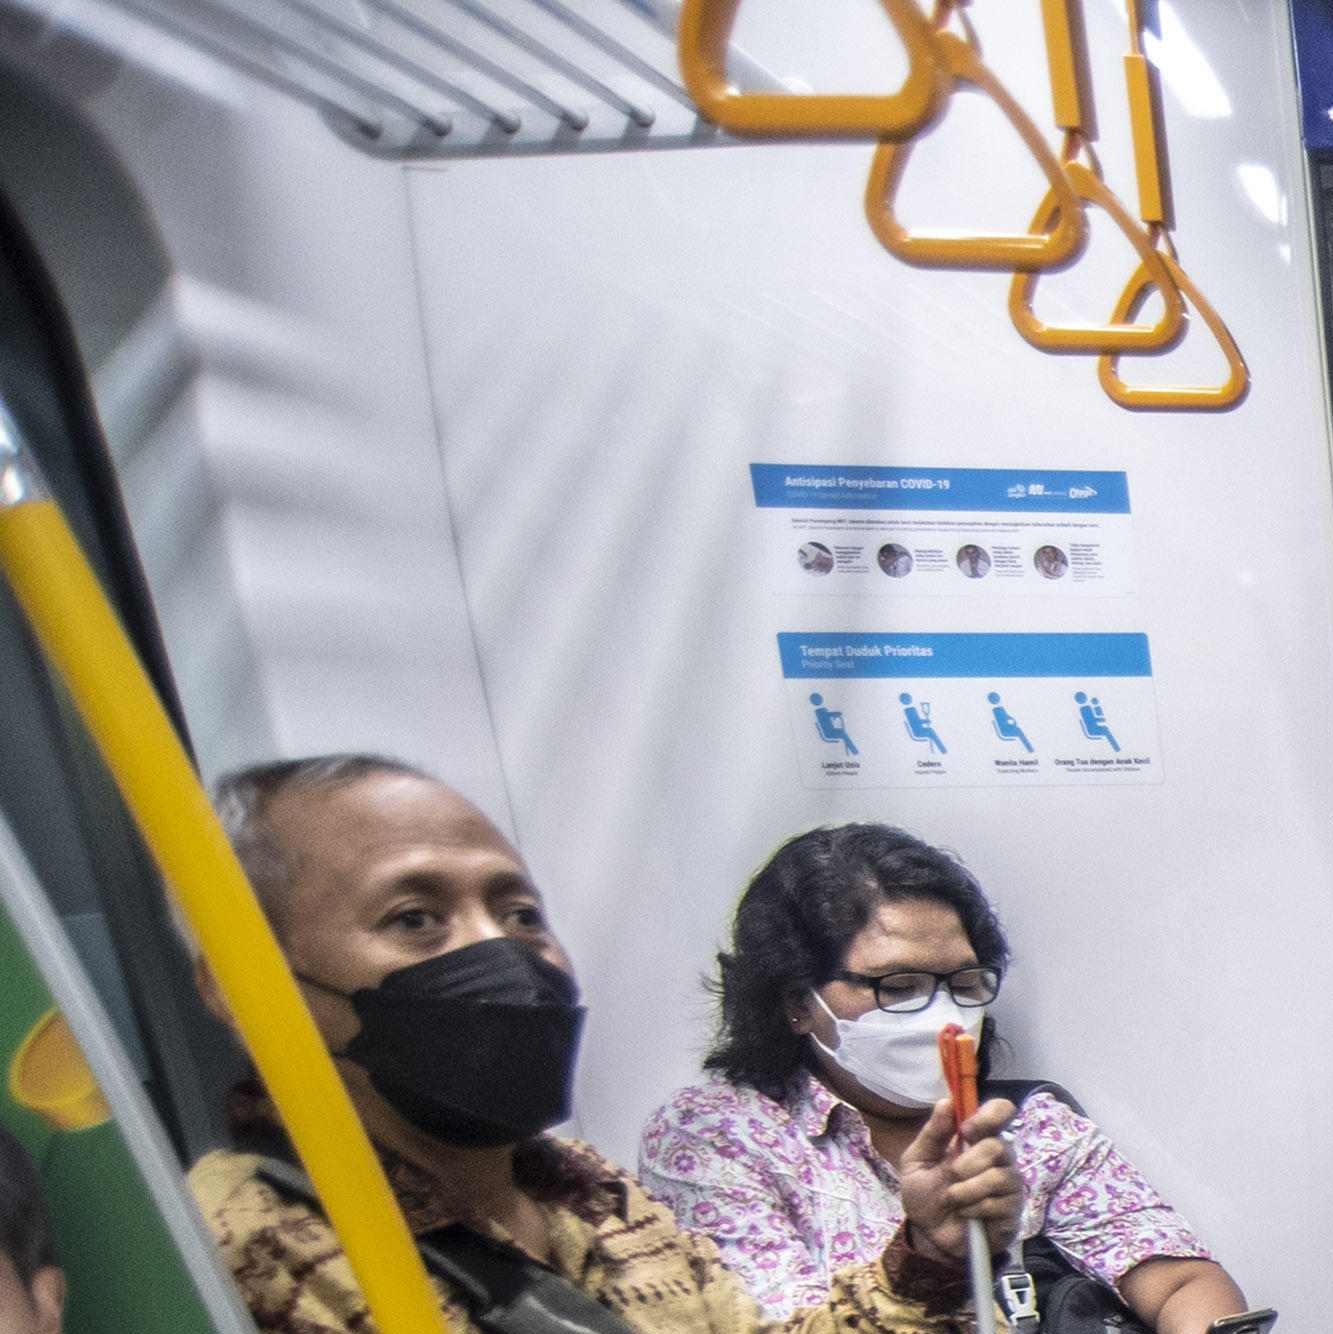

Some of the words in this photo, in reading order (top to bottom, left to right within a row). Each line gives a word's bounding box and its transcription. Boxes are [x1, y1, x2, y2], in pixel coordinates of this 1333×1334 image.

[785, 477, 836, 489] Antisipasi
[838, 478, 898, 490] Penyebaran
[900, 479, 950, 490] COVID-19
[801, 646, 843, 658] Tempat
[846, 646, 882, 656] Duduk
[884, 645, 933, 656] Prioritas
